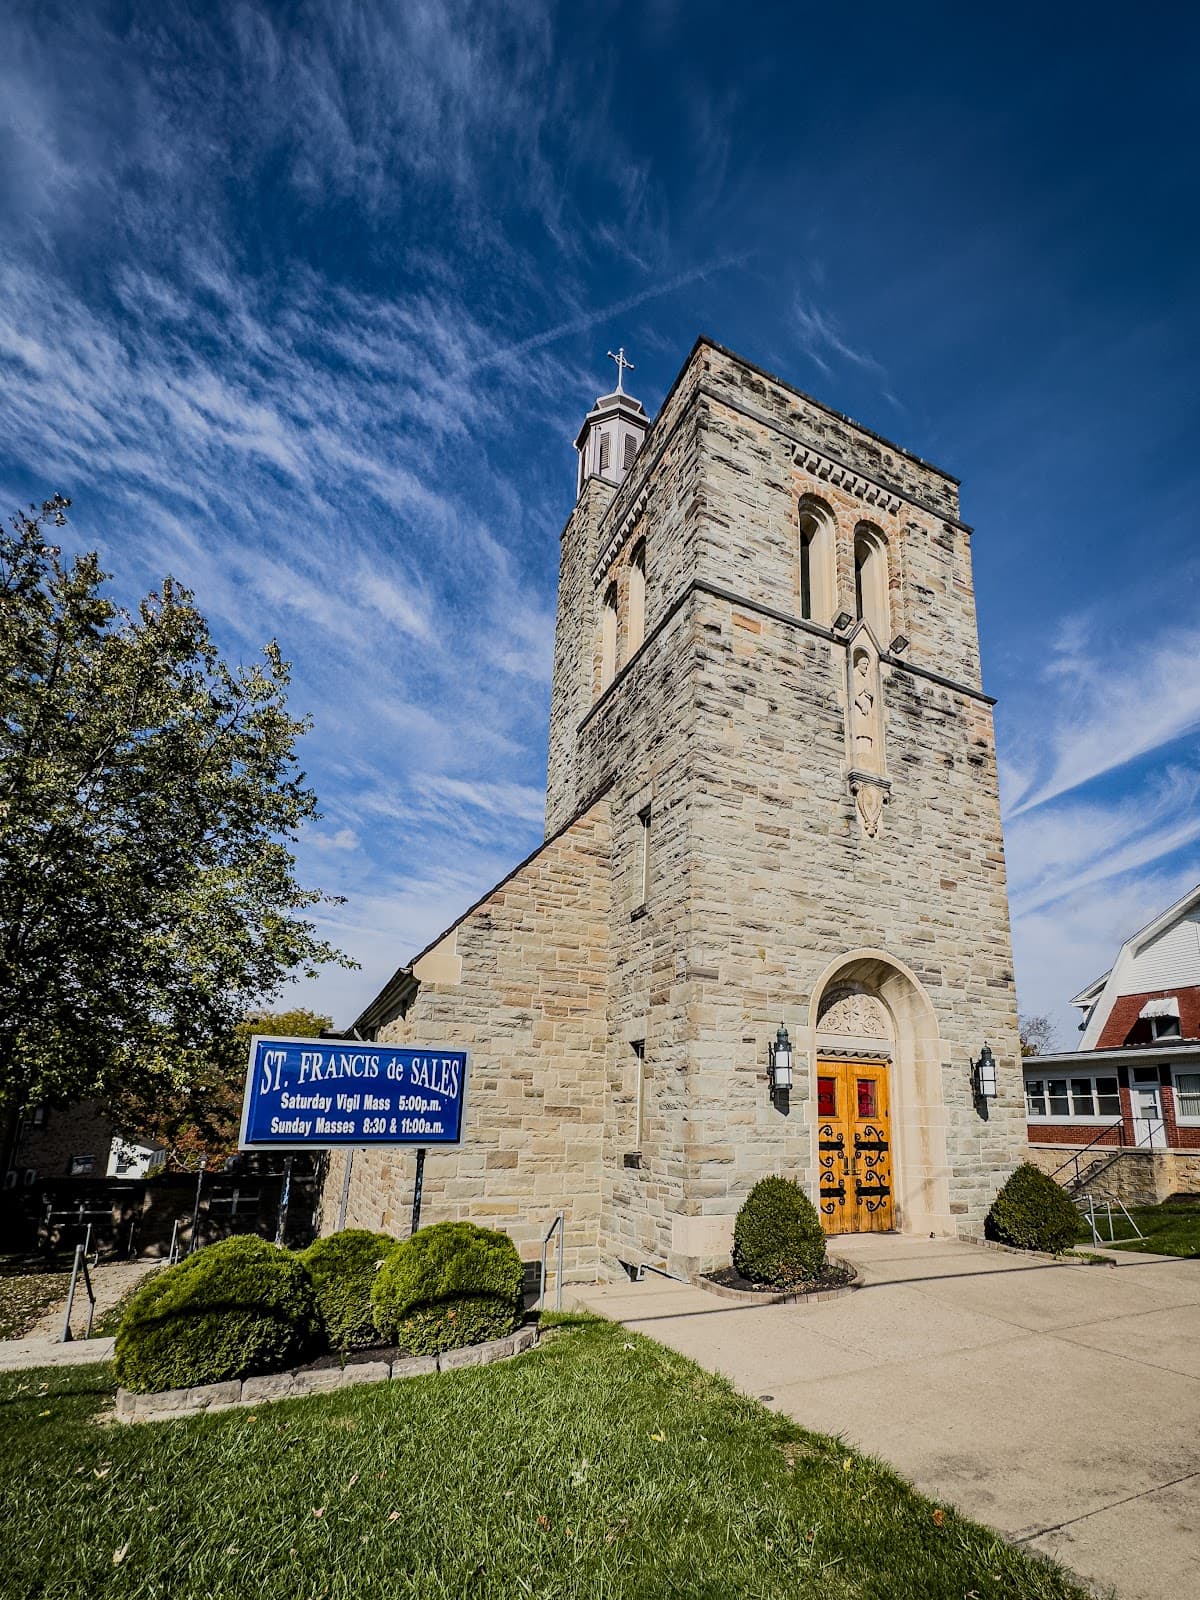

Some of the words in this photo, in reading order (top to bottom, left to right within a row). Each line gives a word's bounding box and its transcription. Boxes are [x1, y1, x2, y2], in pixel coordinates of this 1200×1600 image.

[260, 1050, 288, 1095] ST.
[297, 1052, 379, 1084] FRANCIS
[387, 1057, 404, 1081] de
[411, 1057, 459, 1099] SALES
[280, 1092, 332, 1113] Saturday
[336, 1093, 360, 1113] Vigil
[363, 1094, 390, 1111] Mass
[398, 1096, 442, 1114] 5:00p.m.
[271, 1117, 312, 1137] Sunday
[315, 1117, 355, 1134] Masses
[363, 1118, 386, 1134] 8:30
[389, 1119, 397, 1134] &
[401, 1119, 444, 1134] 11:00a.m.
